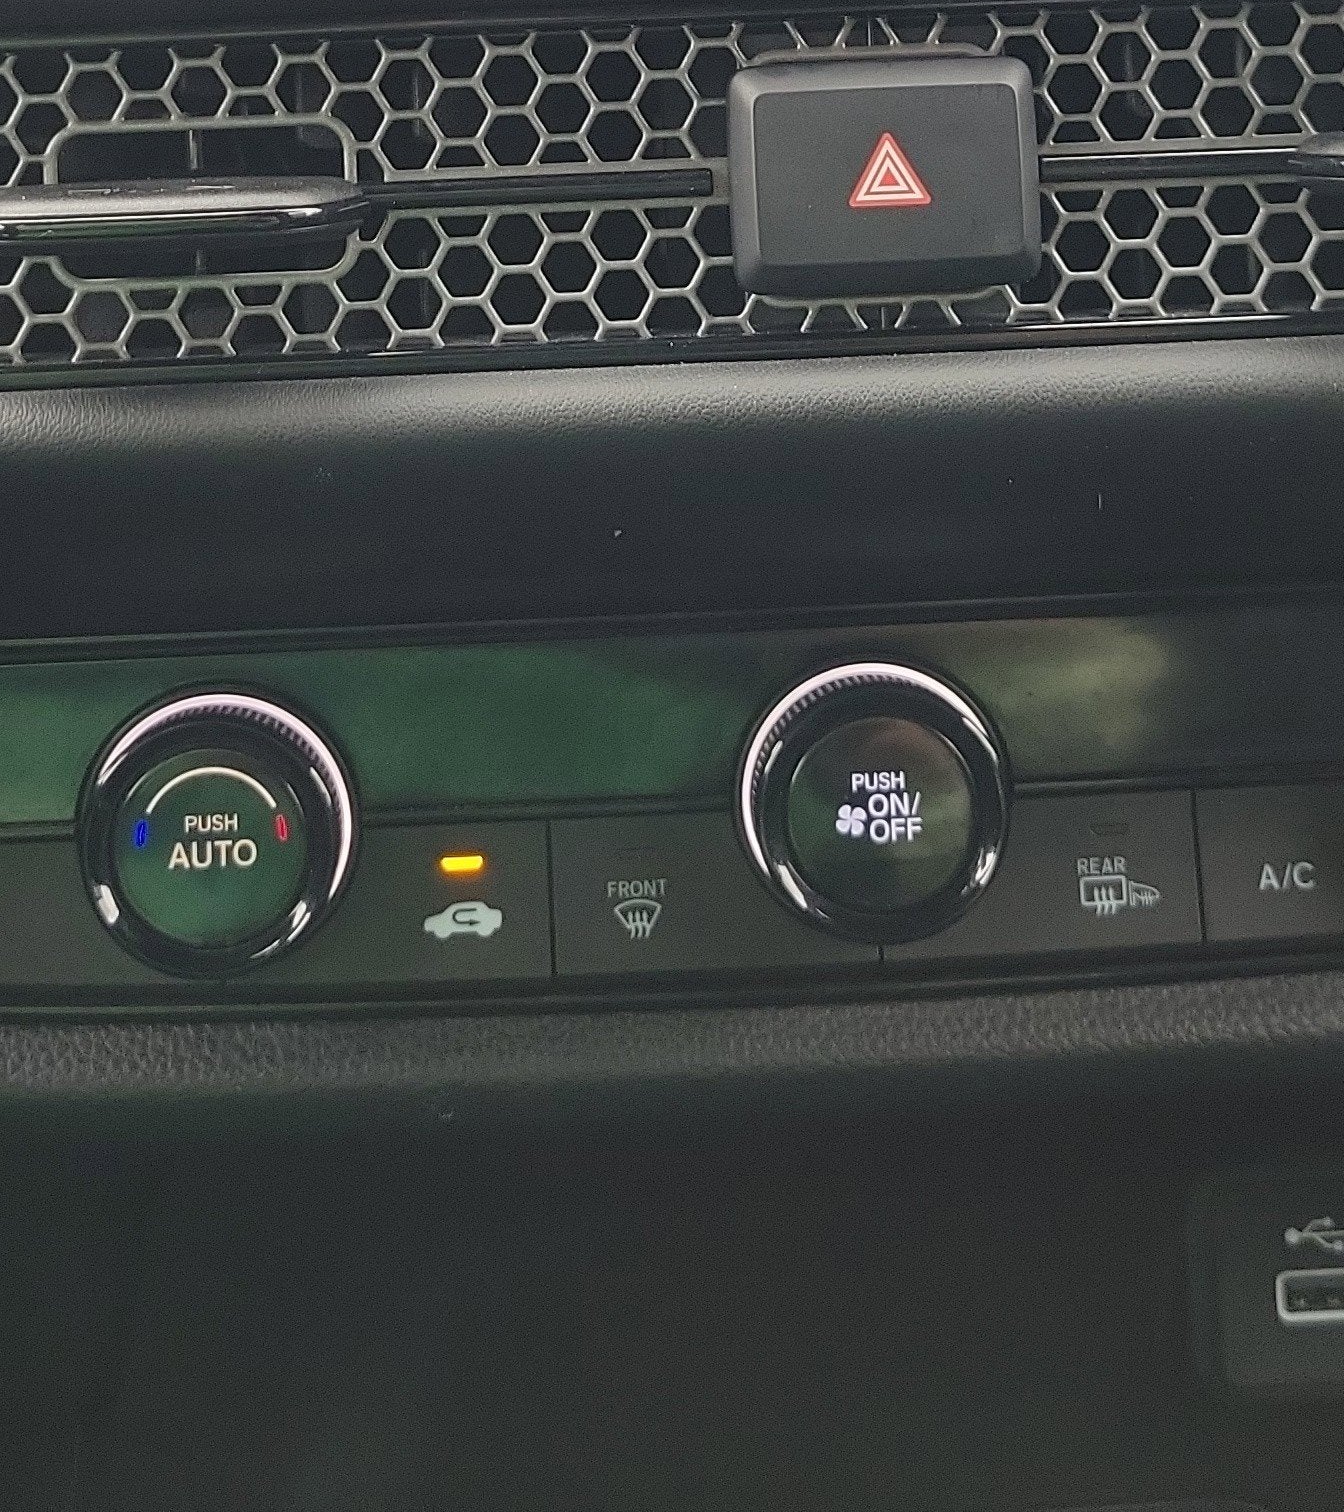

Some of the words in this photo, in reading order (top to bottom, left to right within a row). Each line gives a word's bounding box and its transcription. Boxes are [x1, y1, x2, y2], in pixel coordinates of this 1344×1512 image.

[851, 770, 906, 793] PUSH
[868, 791, 921, 818] ON/
[184, 813, 238, 833] PUSH
[869, 816, 923, 843] OFF
[167, 838, 257, 870] AUTO
[1077, 856, 1126, 875] REAR
[607, 878, 666, 898] FRONT
[1259, 862, 1314, 891] A/C
